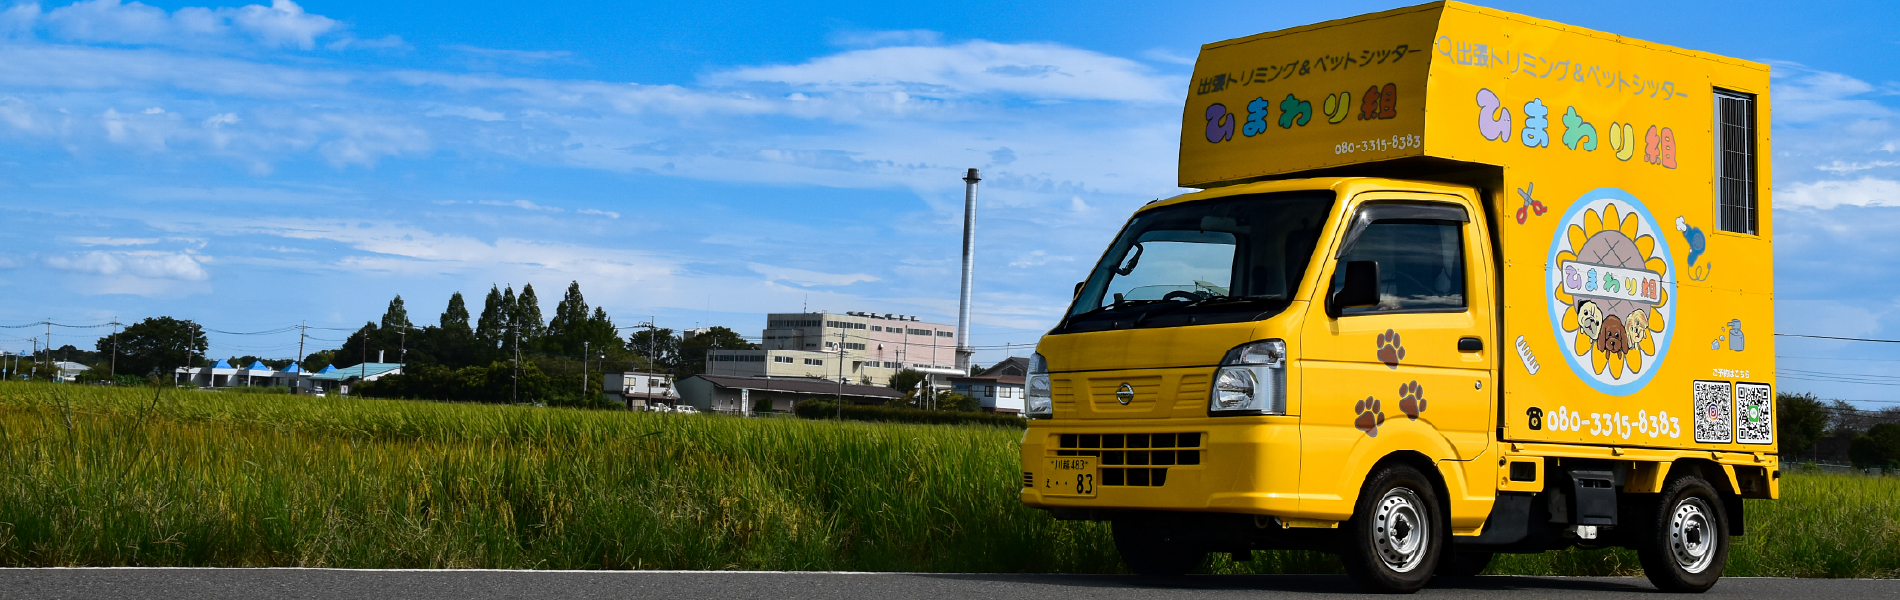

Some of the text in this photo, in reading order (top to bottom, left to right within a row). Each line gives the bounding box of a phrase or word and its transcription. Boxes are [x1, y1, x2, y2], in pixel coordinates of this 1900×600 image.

[1205, 83, 1397, 143] ひまわり組
[1476, 87, 1677, 169] ひまわり組
[1335, 133, 1421, 155] 080-3315-8383
[1565, 264, 1657, 300] ひまわり組
[1712, 368, 1750, 379] ご予約はこちら
[1547, 405, 1681, 439] 080-3315-8383
[1076, 473, 1093, 494] 83
